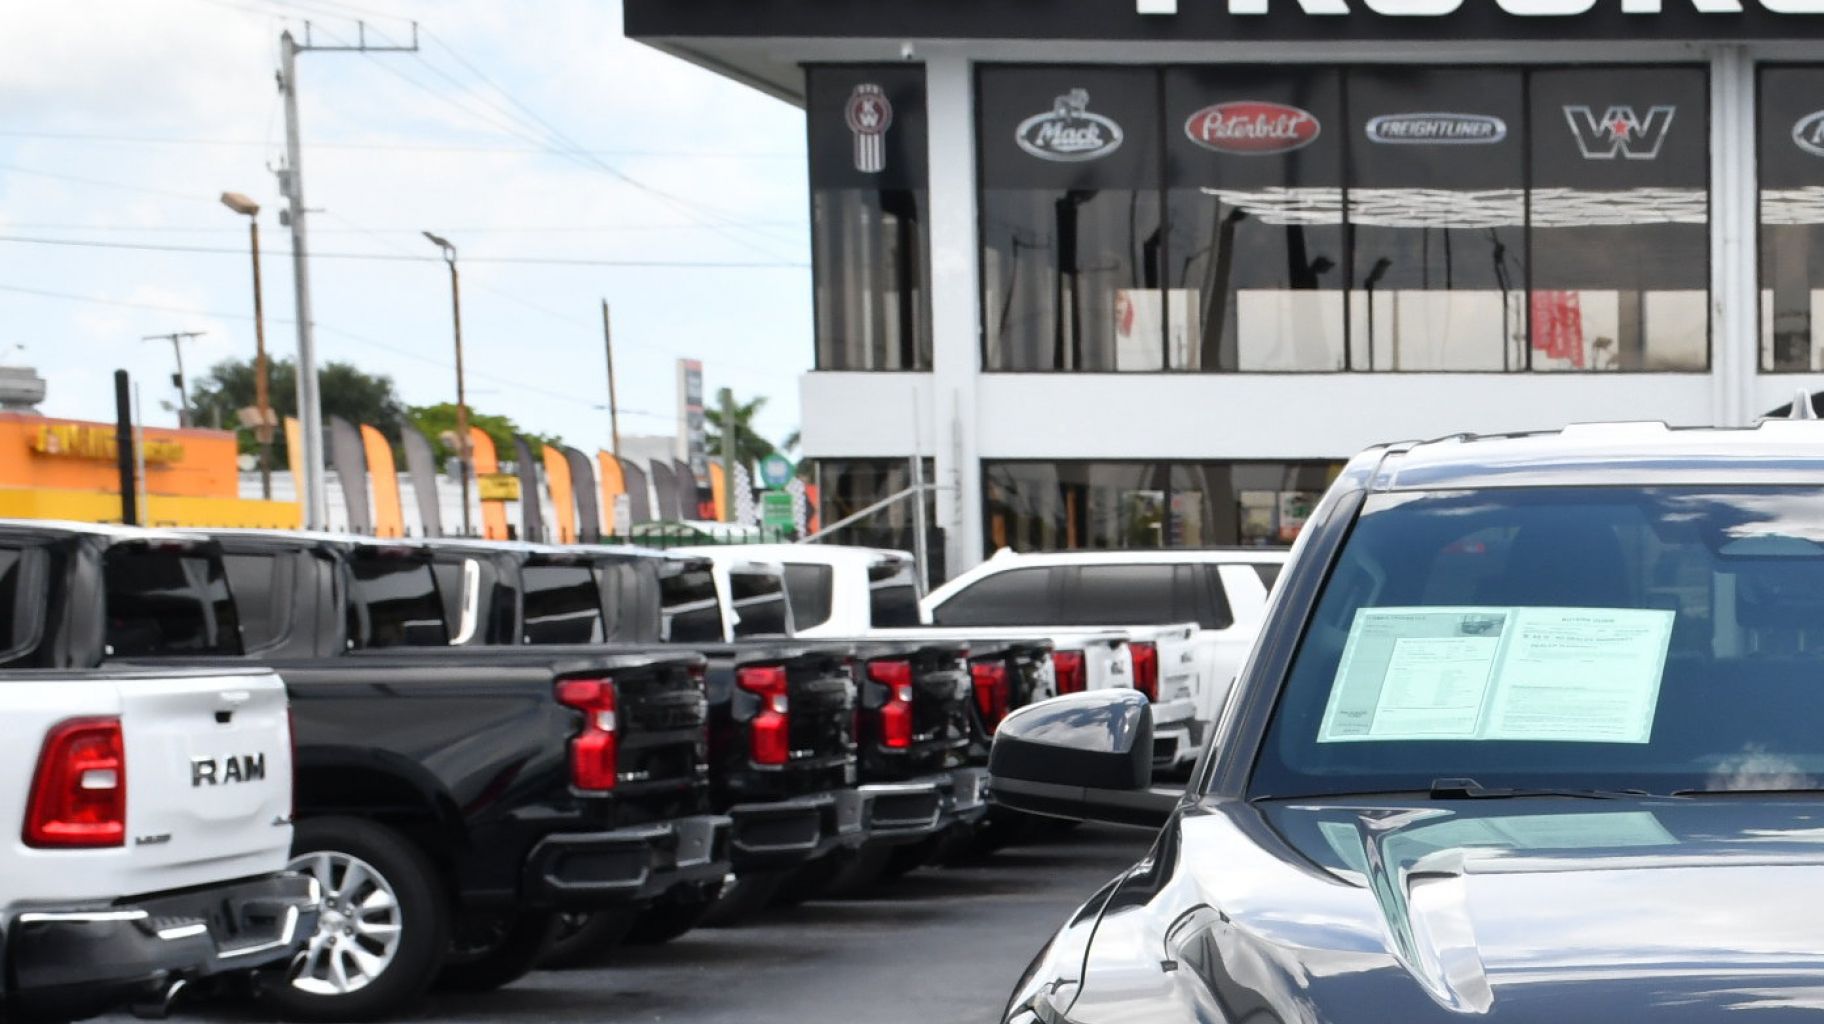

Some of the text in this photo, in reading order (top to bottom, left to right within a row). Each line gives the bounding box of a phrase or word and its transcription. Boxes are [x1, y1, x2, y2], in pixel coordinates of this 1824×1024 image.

[1036, 122, 1103, 151] Mack
[1202, 112, 1309, 141] Peterbilt
[1380, 121, 1493, 137] FREIGHTLINER
[191, 752, 265, 788] RAM
